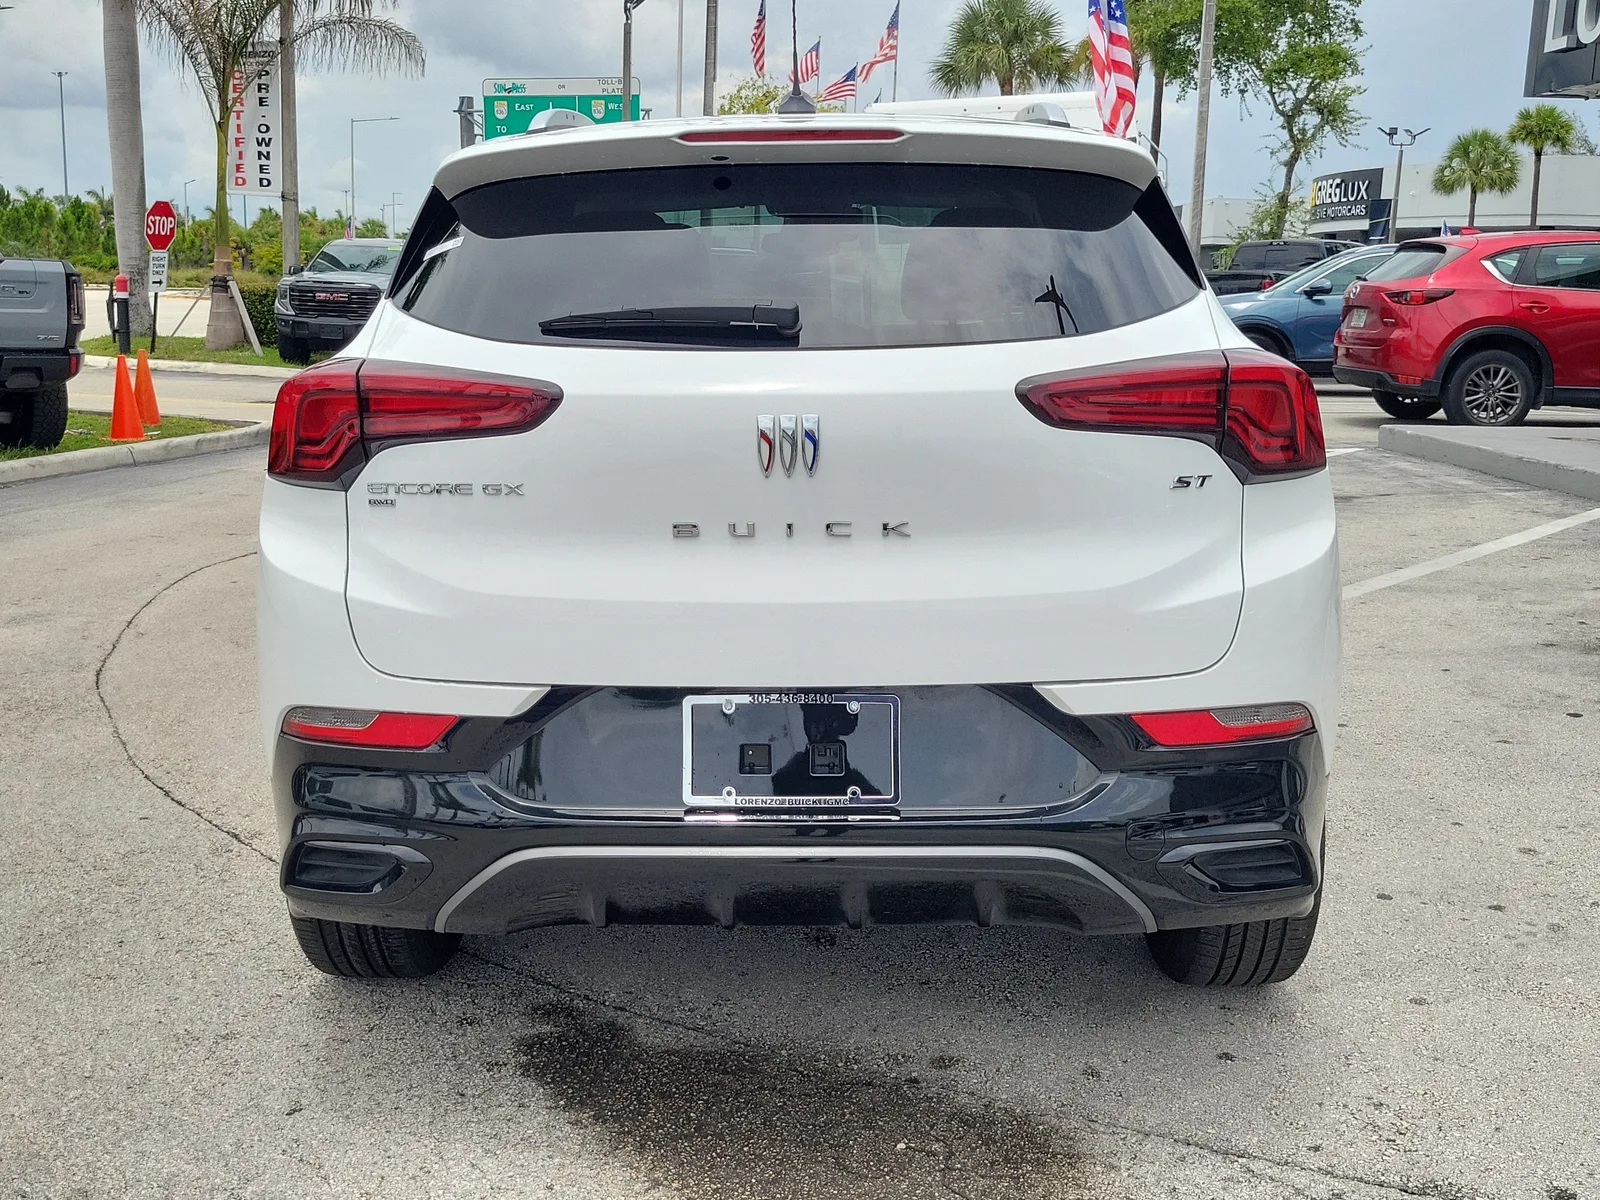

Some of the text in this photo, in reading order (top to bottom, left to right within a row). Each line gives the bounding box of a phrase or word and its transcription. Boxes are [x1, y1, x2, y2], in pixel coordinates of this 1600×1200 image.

[597, 78, 623, 86] TOLL-B
[514, 103, 534, 111] EAST
[607, 102, 624, 111] WES
[231, 69, 247, 187] CERTIFIED
[495, 125, 507, 134] TO
[1327, 204, 1367, 218] MOTORCARS
[147, 215, 175, 236] STOP
[314, 292, 349, 301] GMC
[1169, 473, 1213, 490] ST
[367, 482, 525, 496] ENCORE GX
[368, 498, 397, 507] AWD
[672, 520, 911, 538] BUICK
[748, 693, 835, 704] 305-436-8400
[734, 797, 850, 806] LORENZO BUICK GMC
